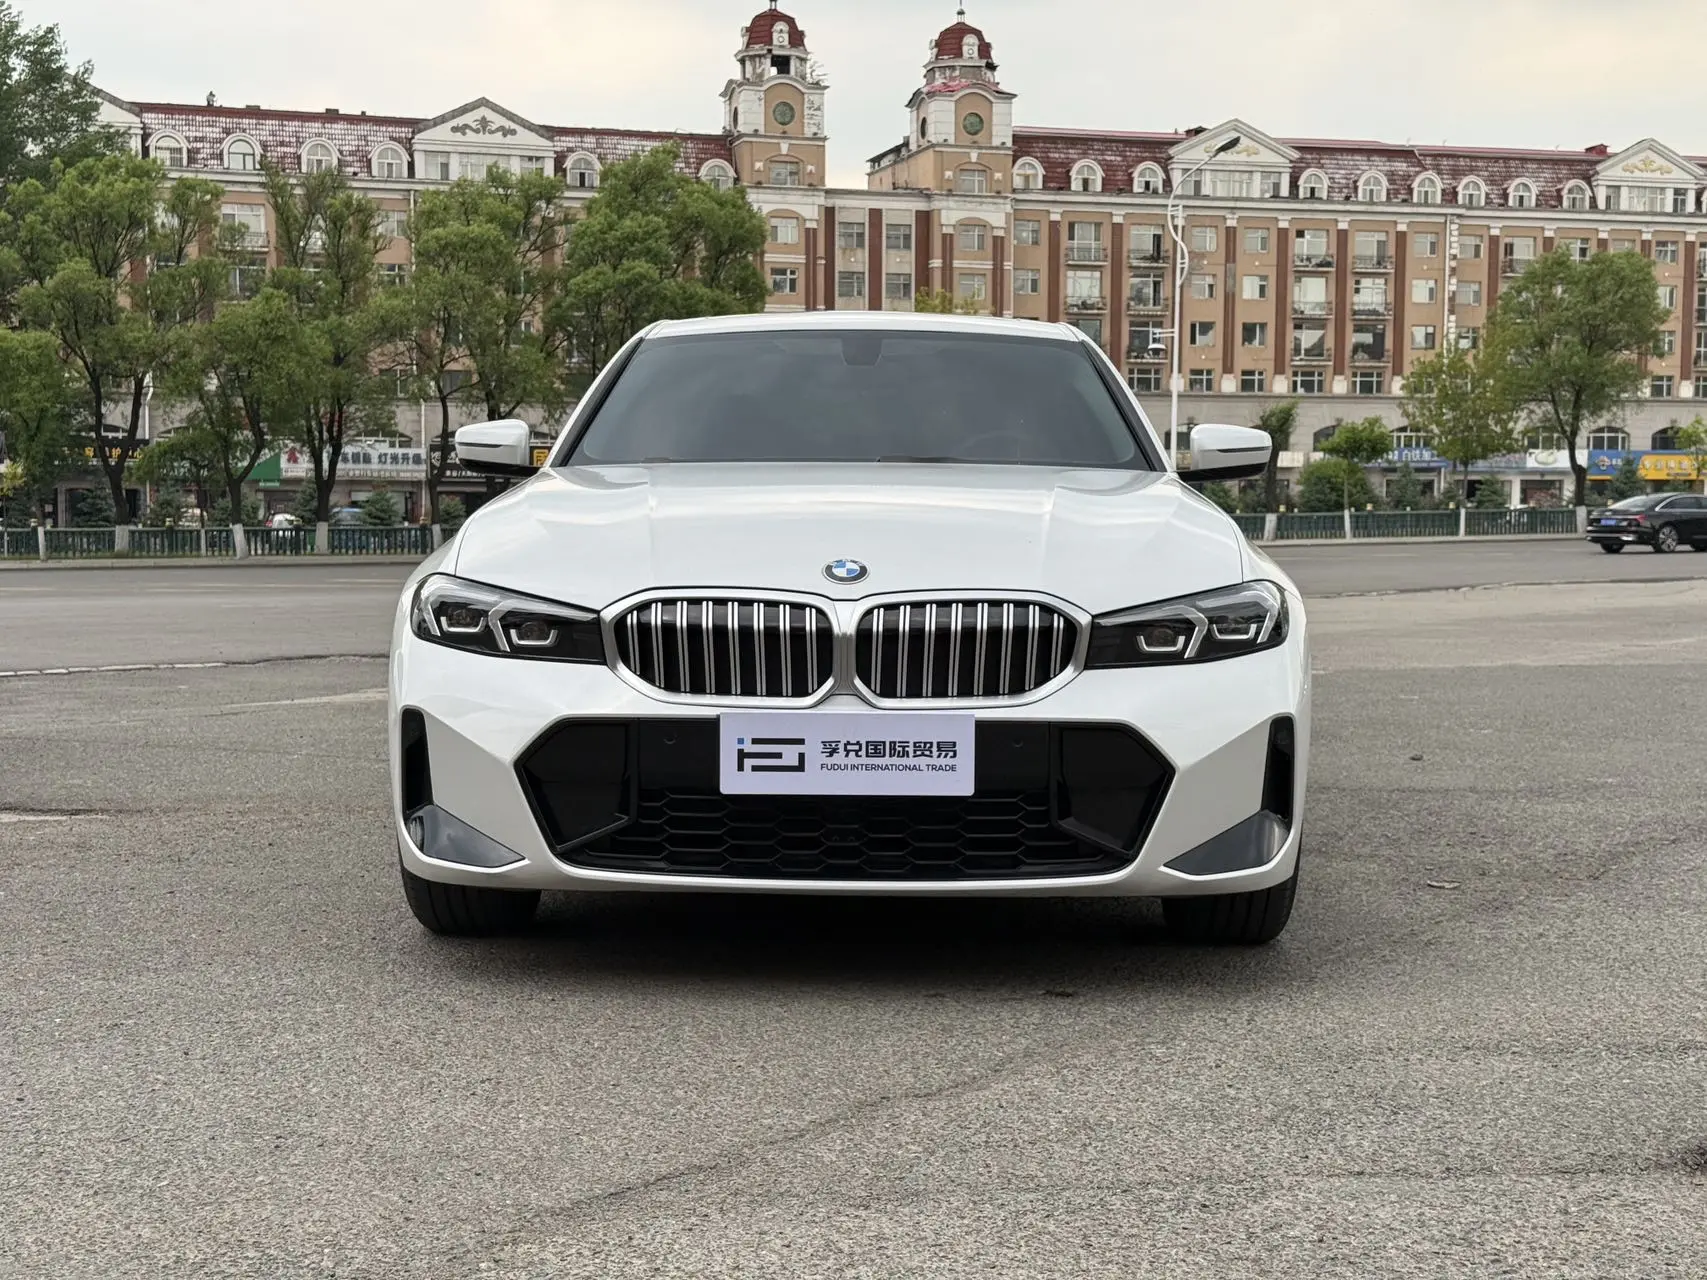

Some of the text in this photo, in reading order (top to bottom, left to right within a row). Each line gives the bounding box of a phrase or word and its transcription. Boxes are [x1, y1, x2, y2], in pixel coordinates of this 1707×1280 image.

[820, 740, 957, 759] 孚兑国际贸易
[820, 763, 957, 772] FUDUI INTERNATIONAL TRADE
